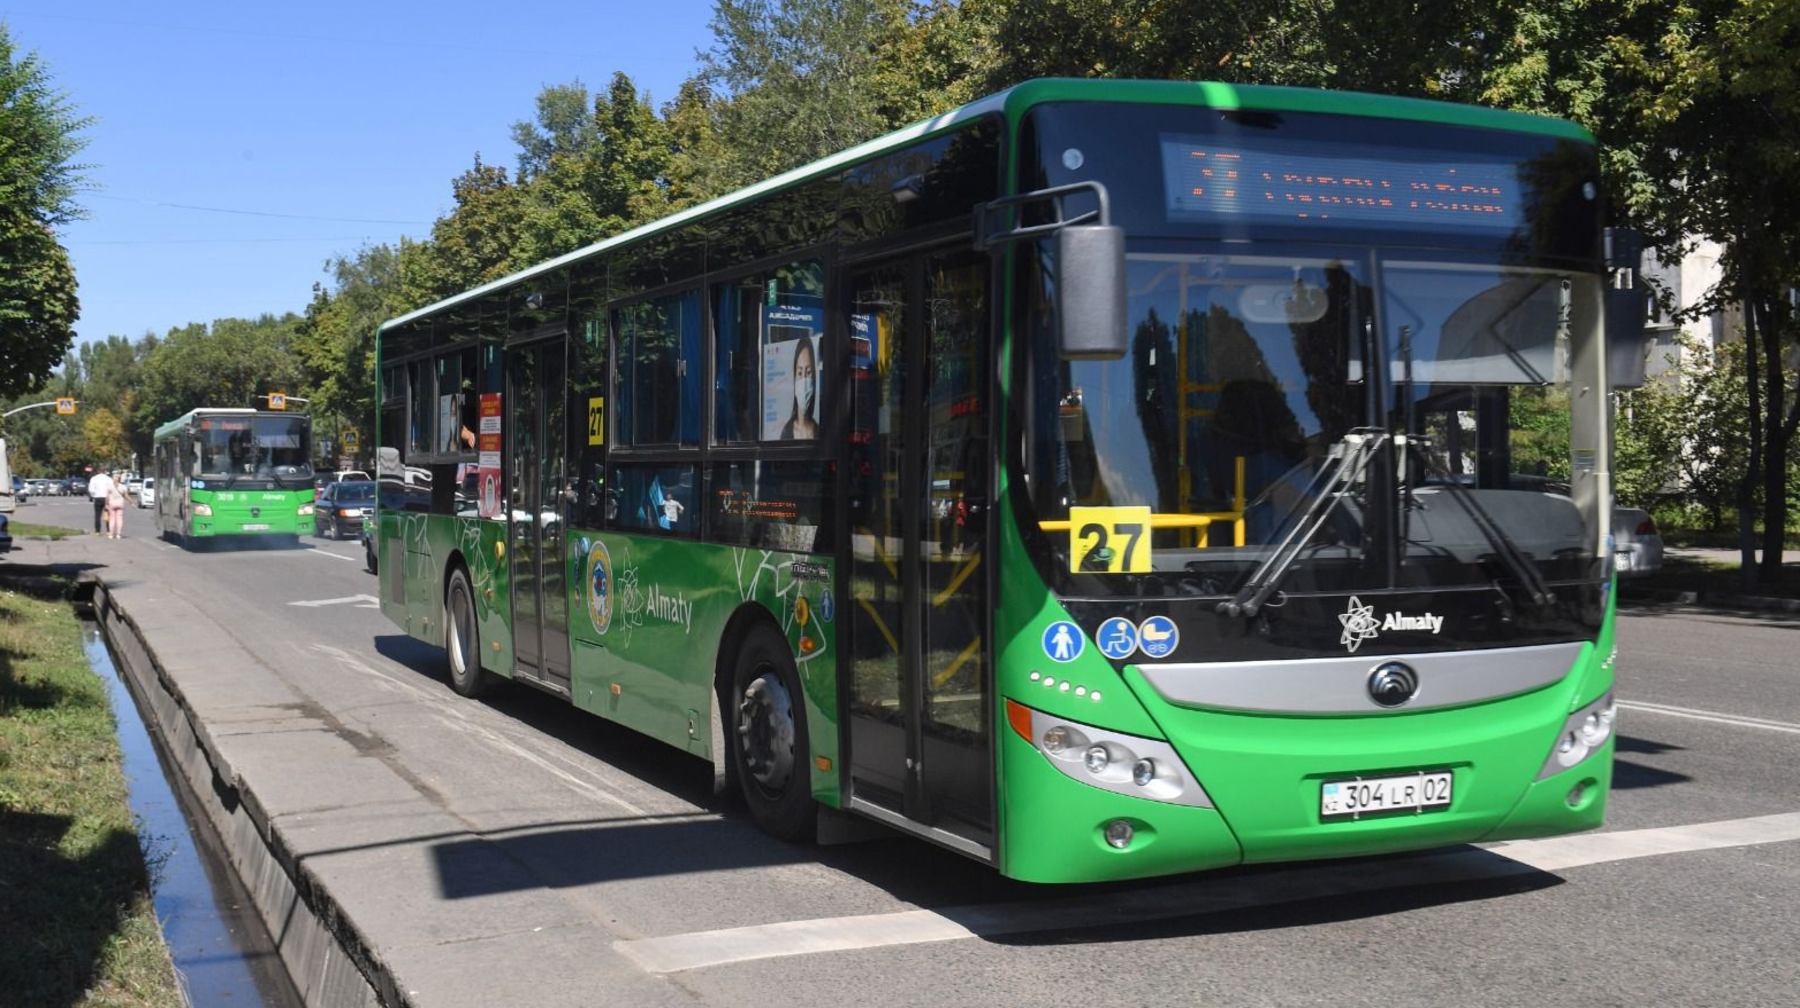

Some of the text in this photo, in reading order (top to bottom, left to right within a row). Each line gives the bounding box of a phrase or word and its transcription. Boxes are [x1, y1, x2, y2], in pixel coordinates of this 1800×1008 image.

[590, 406, 603, 436] 27
[262, 492, 287, 501] Almaty
[1078, 522, 1144, 572] 27
[646, 582, 693, 635] Almaty
[1381, 611, 1444, 634] Almaty
[1324, 777, 1448, 811] KZ 304 LR 02
